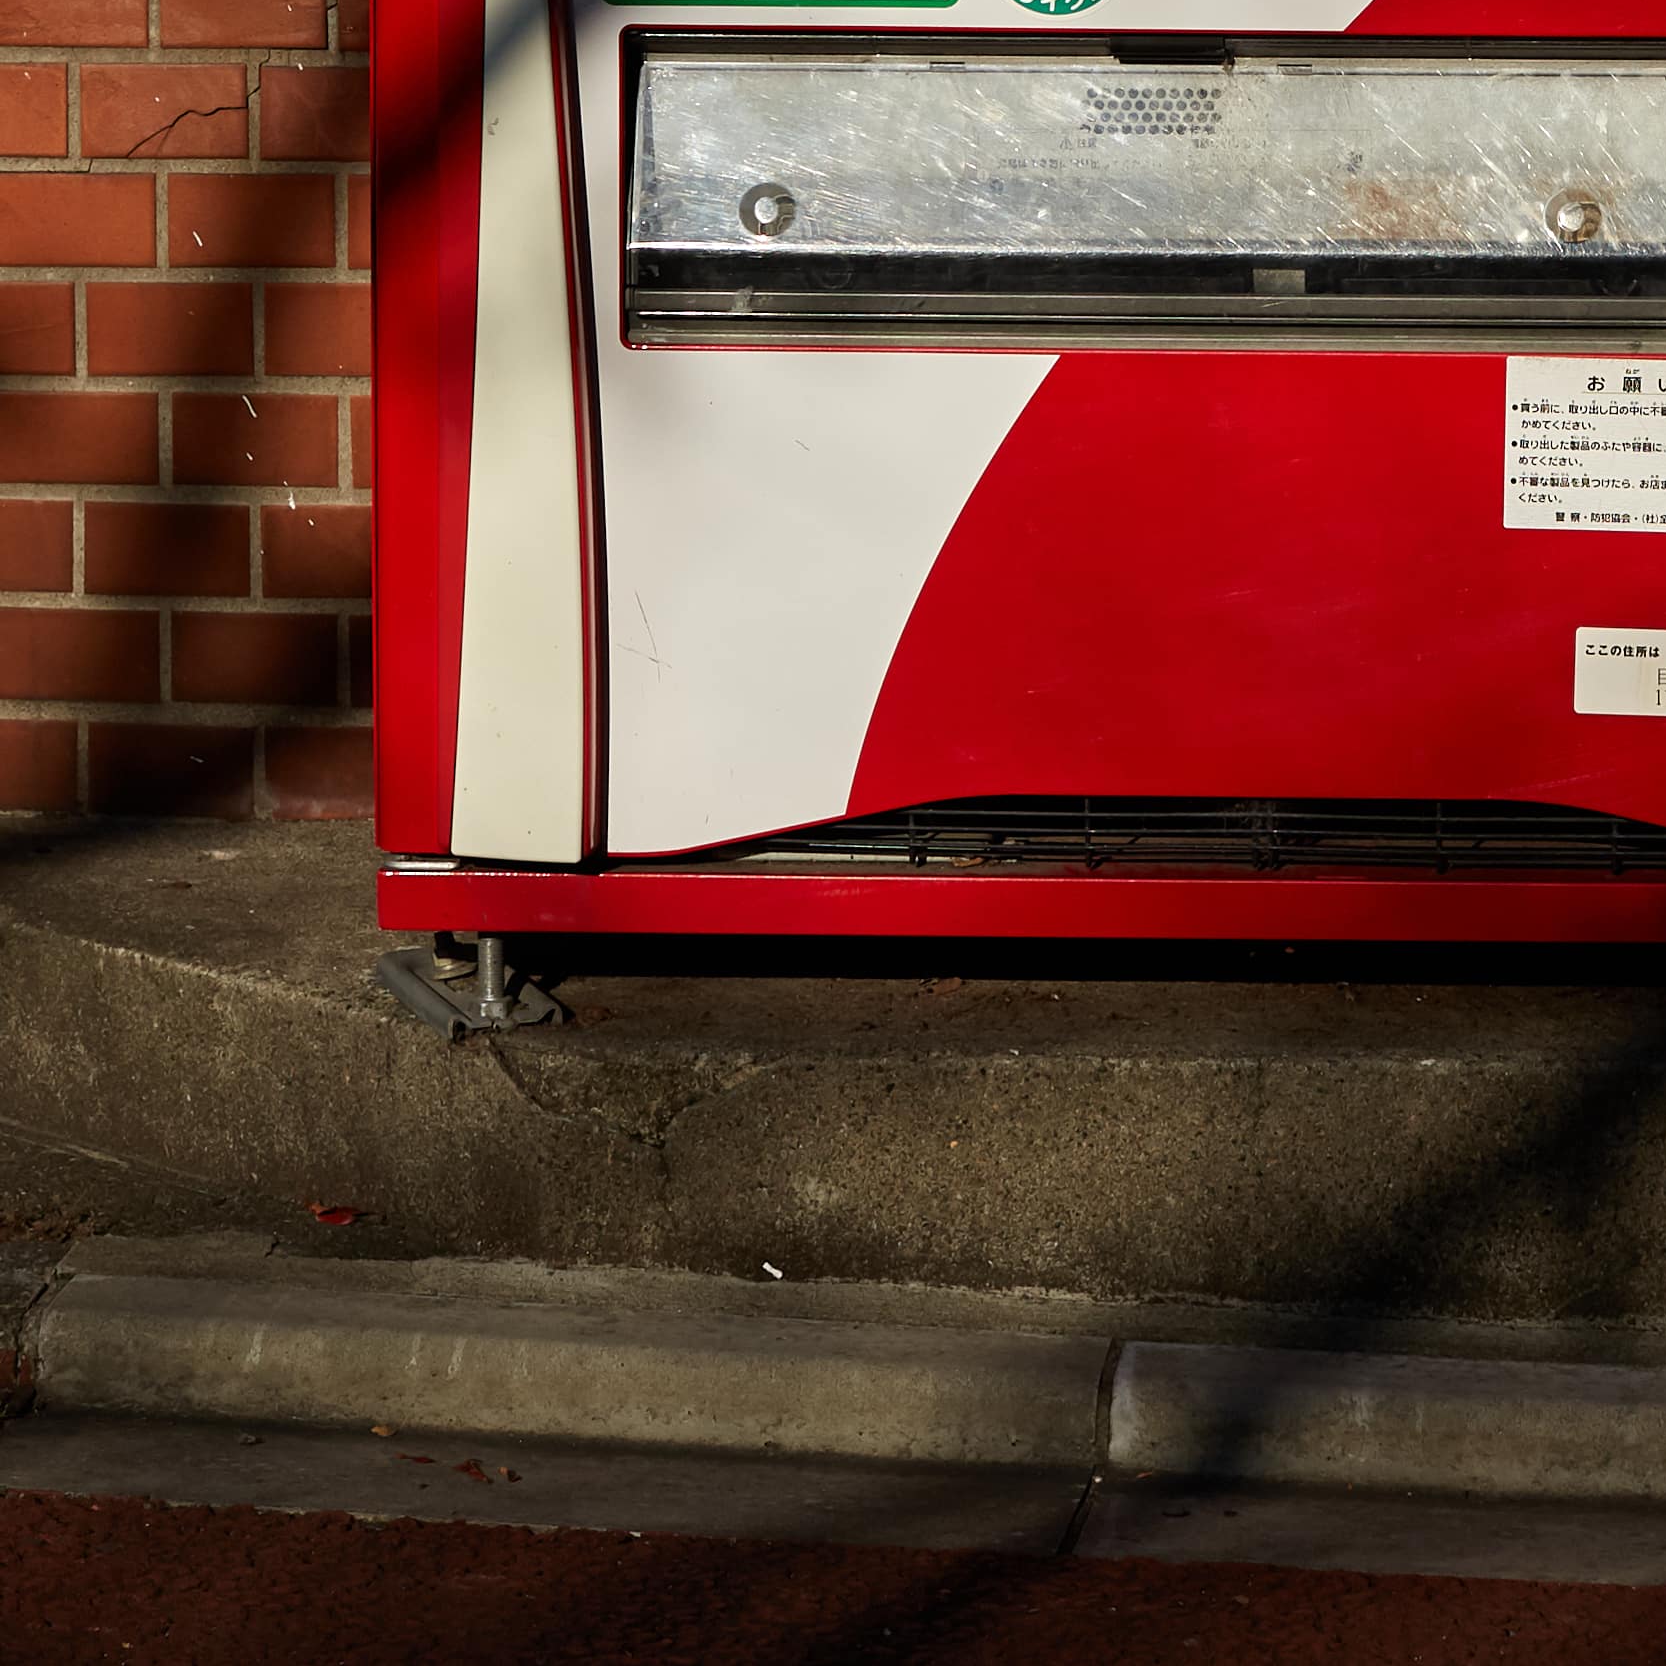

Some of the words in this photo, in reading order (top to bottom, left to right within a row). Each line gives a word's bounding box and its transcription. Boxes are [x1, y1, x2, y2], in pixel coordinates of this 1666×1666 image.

[1521, 420, 1597, 431] かめてください。
[1519, 456, 1584, 467] めてください。
[1519, 493, 1563, 504] ください。
[1585, 644, 1660, 658] ここの住所は
